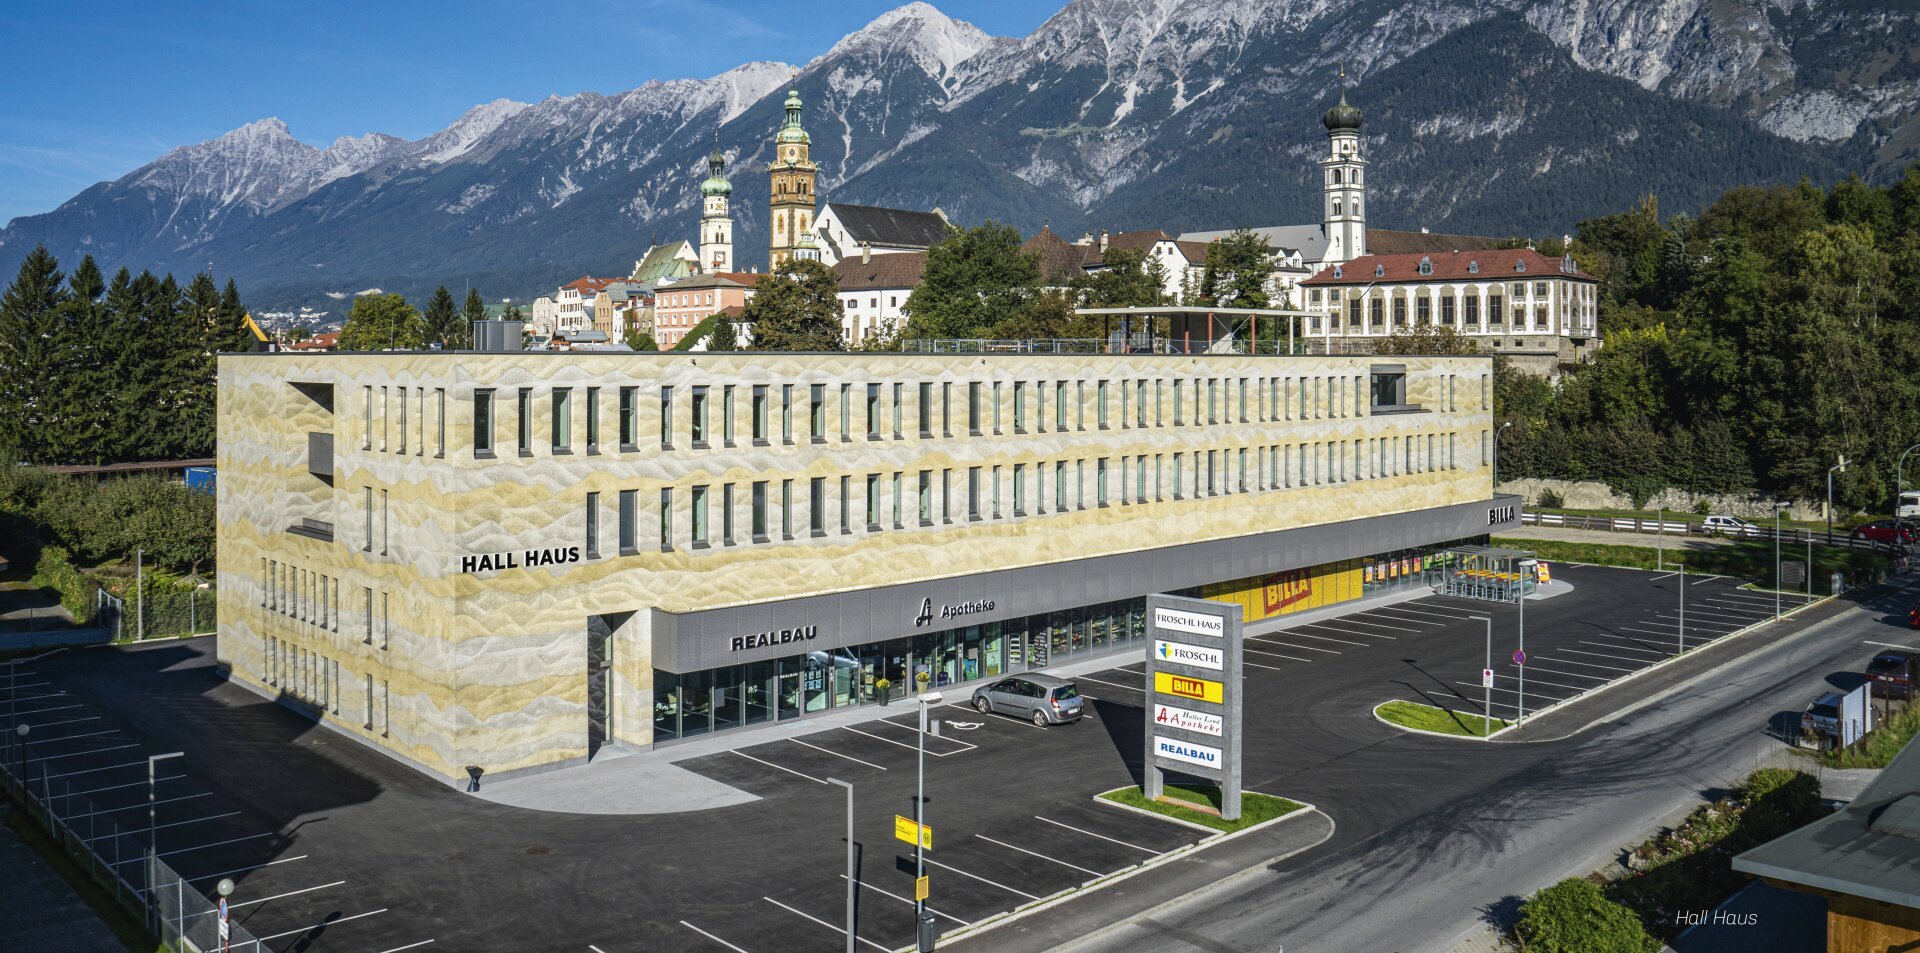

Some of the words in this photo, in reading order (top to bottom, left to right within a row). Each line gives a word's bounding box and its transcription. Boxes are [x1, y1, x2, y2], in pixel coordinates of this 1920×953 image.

[1487, 506, 1515, 526] BILLA
[461, 552, 518, 573] HALL
[523, 546, 580, 567] HAUS
[1265, 569, 1310, 608] BILLA
[940, 599, 995, 619] Apotheke
[1197, 620, 1221, 630] HAUS
[731, 625, 817, 651] REALBAU
[1173, 678, 1203, 696] BILLA
[1170, 713, 1221, 733] Apotheke
[1161, 742, 1215, 762] REALBAU
